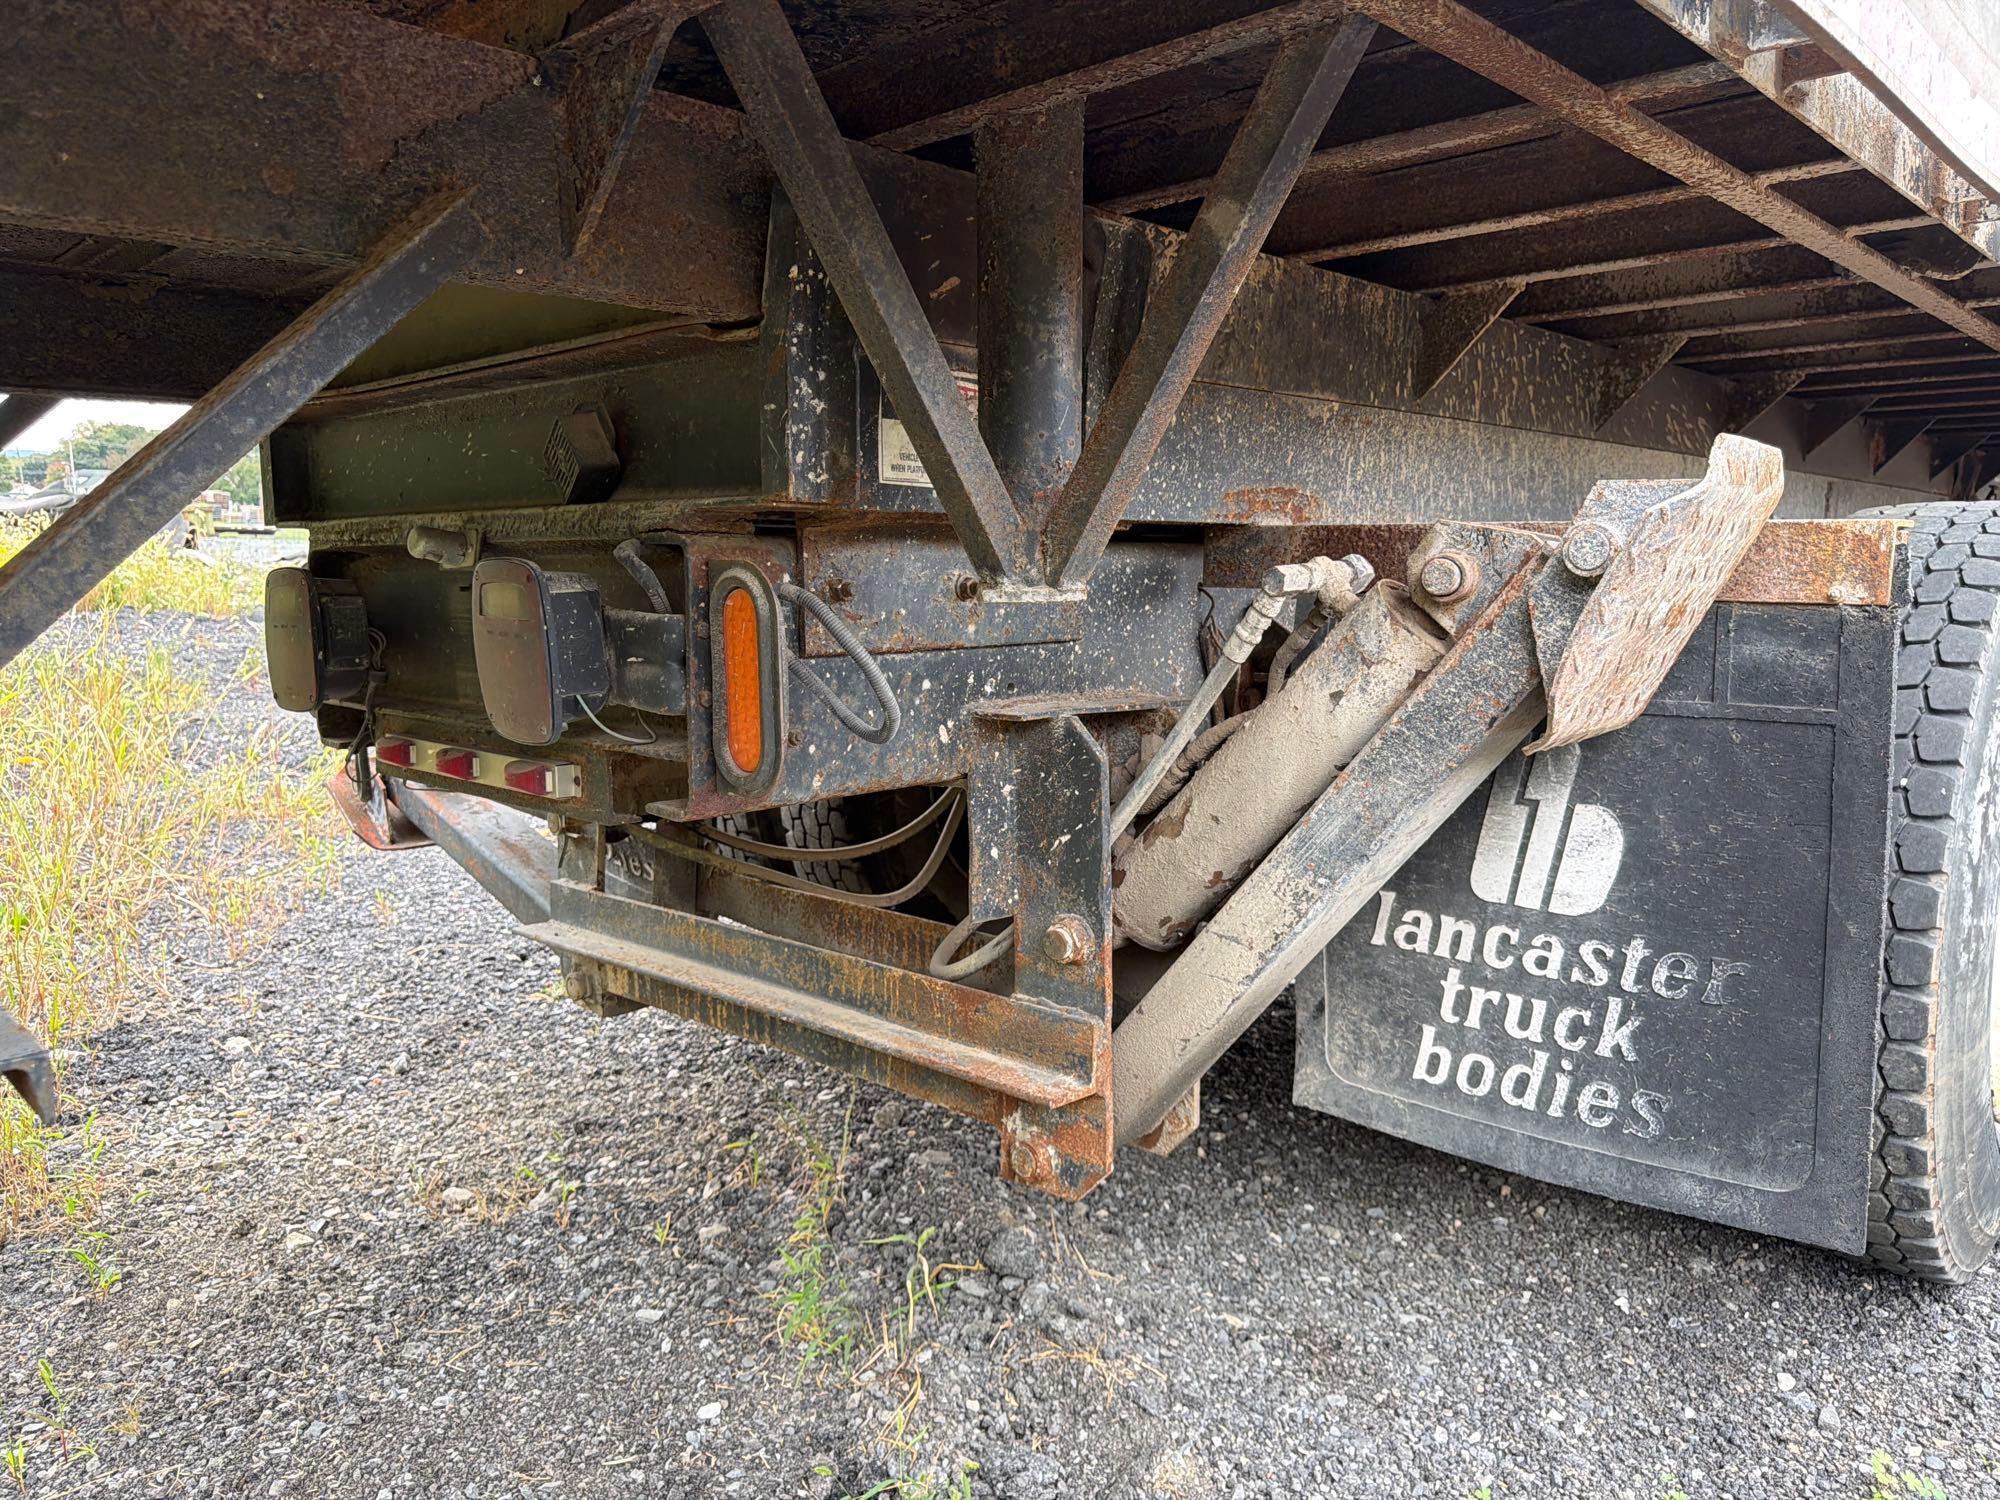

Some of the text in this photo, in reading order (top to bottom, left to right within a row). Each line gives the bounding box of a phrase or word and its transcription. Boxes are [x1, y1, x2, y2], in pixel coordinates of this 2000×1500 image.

[891, 463, 925, 474] WHEN PLATFO
[1370, 890, 1750, 1006] lancaster
[1440, 967, 1644, 1062] truck
[1412, 1024, 1673, 1139] bodies
